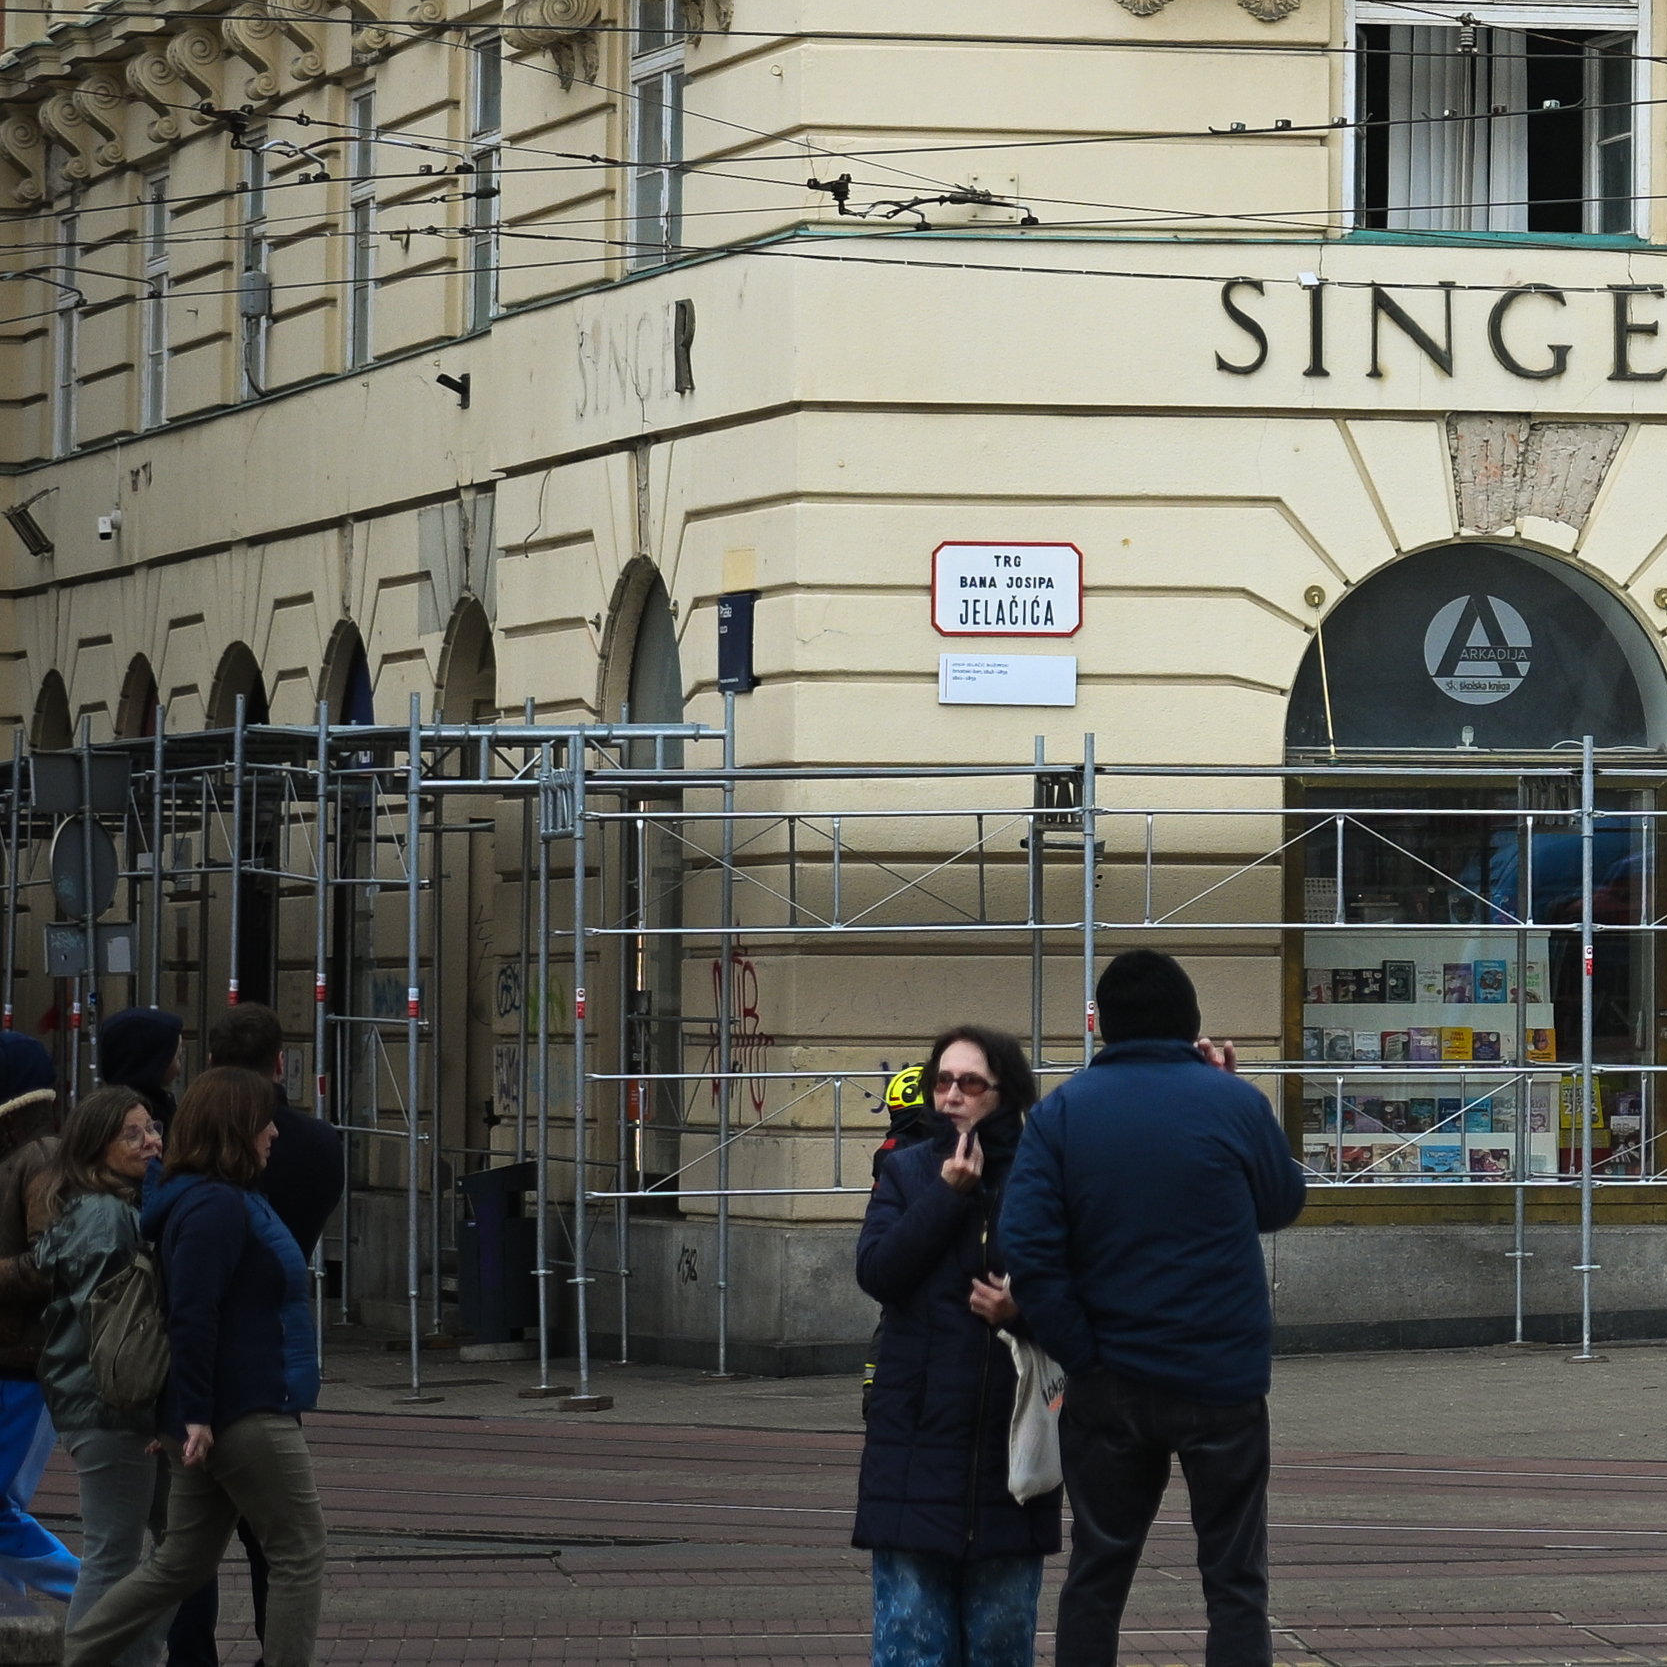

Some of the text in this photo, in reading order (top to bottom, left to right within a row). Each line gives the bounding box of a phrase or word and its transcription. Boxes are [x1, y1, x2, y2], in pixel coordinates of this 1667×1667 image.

[994, 555, 1022, 568] TRG
[960, 576, 1055, 590] BANA JOSIPA
[959, 595, 1055, 626] JELAČIĆA
[1460, 648, 1528, 660] ARKADIJA
